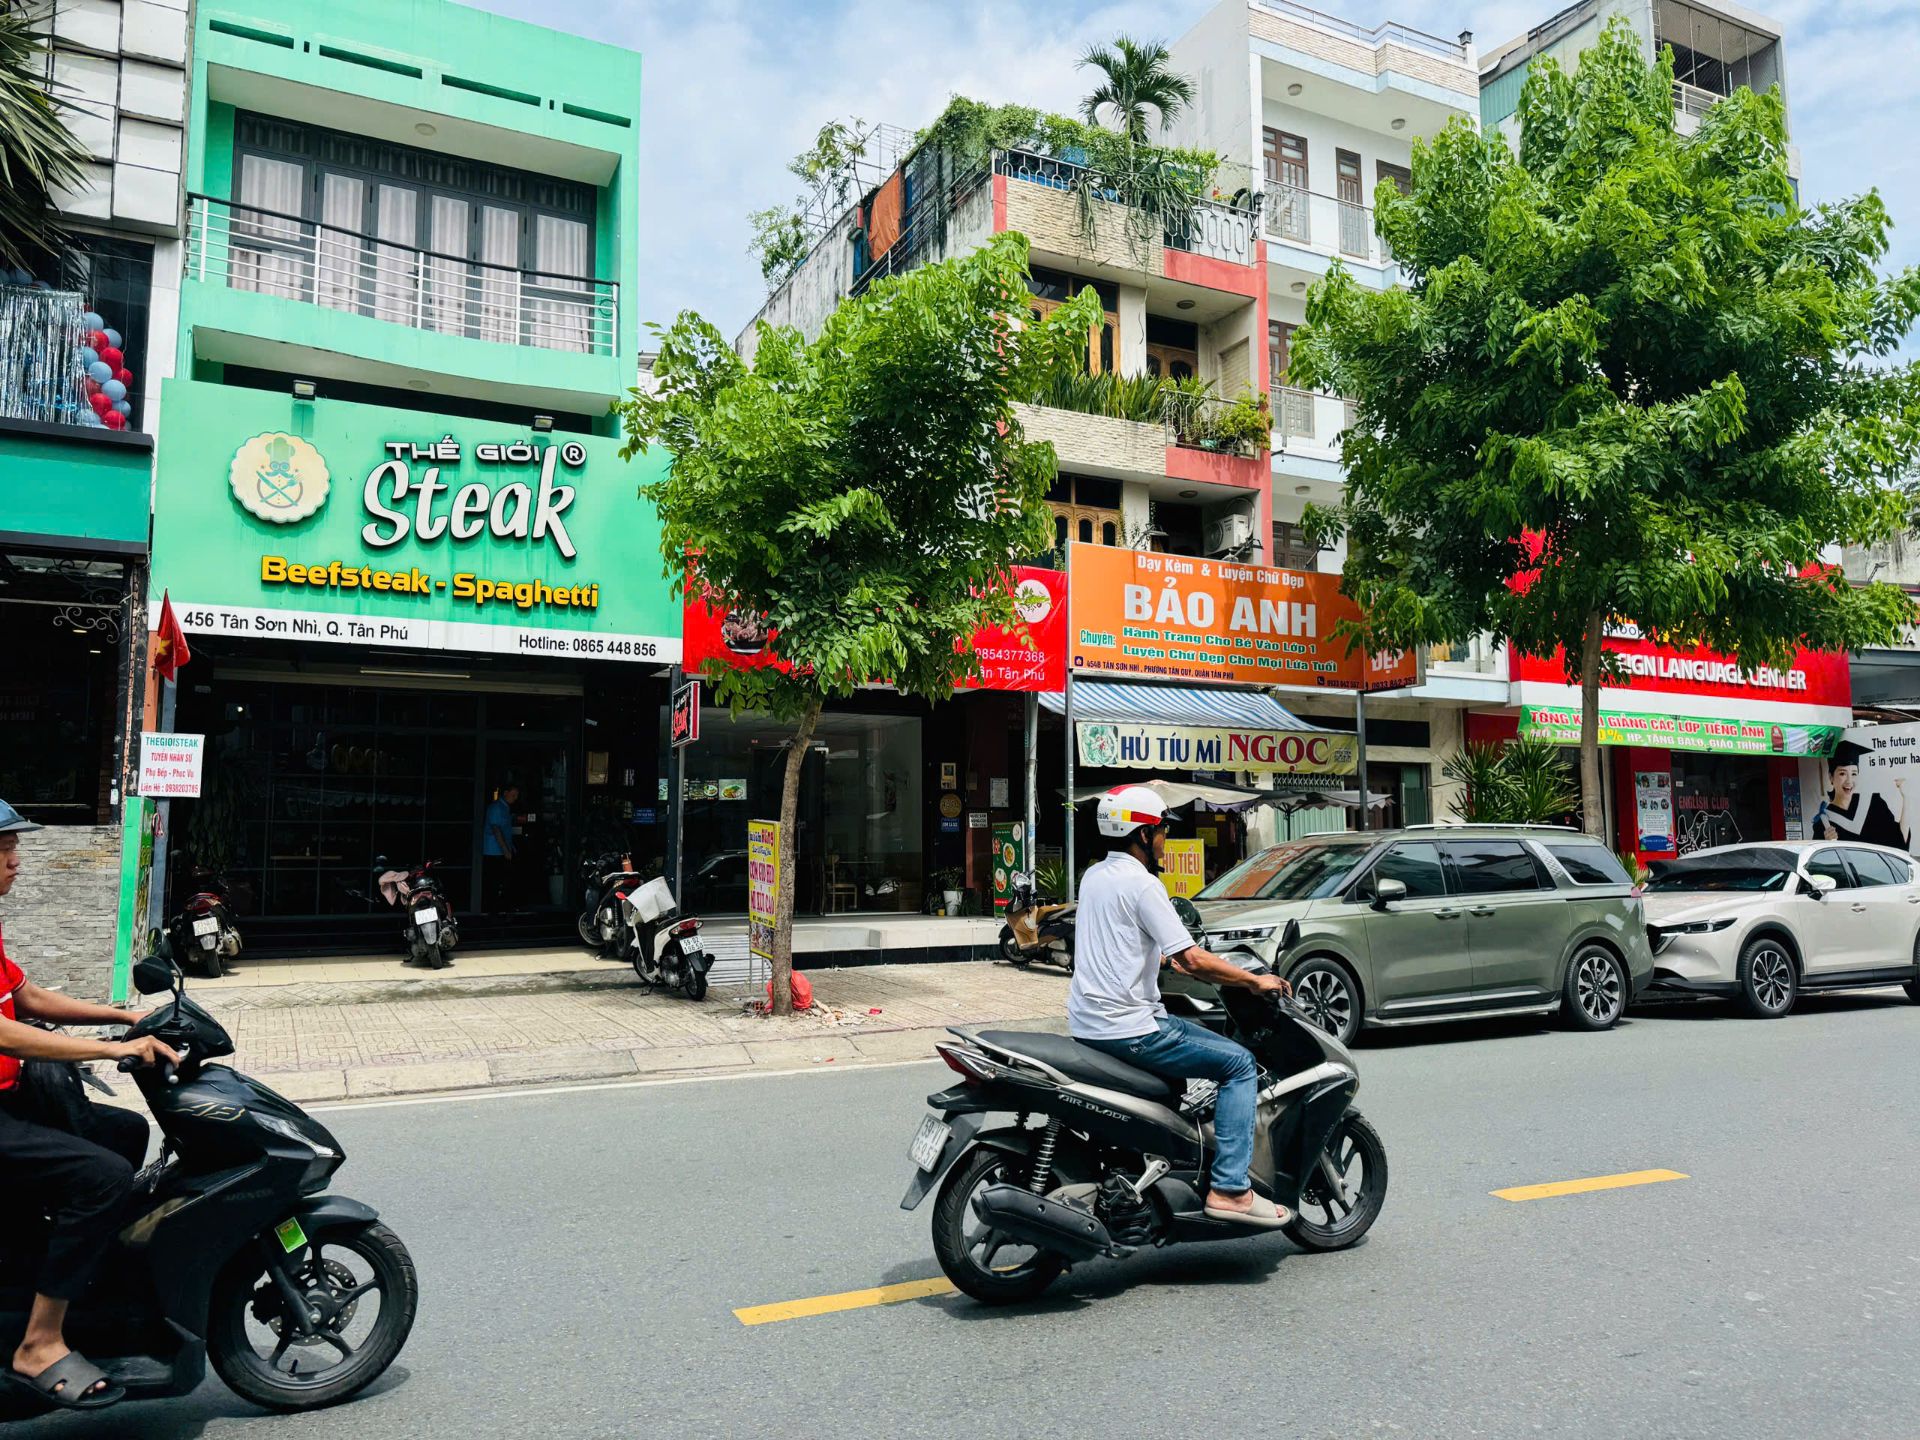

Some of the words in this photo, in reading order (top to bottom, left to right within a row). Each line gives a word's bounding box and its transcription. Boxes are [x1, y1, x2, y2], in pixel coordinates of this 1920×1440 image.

[385, 434, 461, 460] THẾ
[476, 440, 540, 461] GIỚI
[362, 445, 577, 558] Steak
[261, 555, 431, 593] Beefsteak
[453, 573, 599, 608] Spaghetti
[1137, 555, 1161, 574] Dạy
[1165, 558, 1193, 575] Kèm
[1201, 563, 1211, 577] &
[1218, 565, 1253, 582] Luyện
[1256, 569, 1278, 584] Chữ
[1282, 574, 1304, 589] Đẹp
[1124, 576, 1215, 628] BẢO
[1229, 596, 1317, 638] ANH
[183, 611, 215, 627] 456
[220, 613, 249, 630] Tân
[254, 615, 287, 632] Sơn
[292, 619, 321, 637] Nhì,
[326, 621, 343, 636] Q.
[347, 622, 375, 638] Tân
[380, 624, 408, 640] Phú
[519, 634, 569, 651] Hotline:
[572, 638, 604, 653] 0865
[607, 641, 631, 655] 448
[633, 642, 657, 657] 856
[1123, 626, 1159, 640] Hành
[1163, 631, 1202, 645] Trang
[1206, 635, 1231, 648] Cho
[1235, 636, 1252, 649] Bé
[1255, 638, 1279, 652] Vào
[1283, 641, 1305, 654] Lớp
[1309, 644, 1317, 655] 1
[975, 647, 1045, 663] 0854377368
[1123, 645, 1165, 659] Luyện
[1169, 648, 1196, 661] Chữ
[1199, 652, 1225, 665] Đẹp
[1229, 654, 1254, 666] Cho
[1258, 656, 1282, 668] Mọi
[1286, 658, 1309, 670] Lứa
[1311, 659, 1338, 672] Tuổi
[997, 666, 1019, 680] Tân
[1023, 667, 1045, 681] Phú
[1657, 656, 1746, 684] LANGUAGE
[1530, 707, 1569, 724] TỔNG
[1573, 712, 1605, 727] KI
[1607, 711, 1647, 729] GIẢNG
[1650, 716, 1675, 731] CÁC
[1678, 719, 1701, 733] LỚP
[1704, 720, 1738, 735] TIẾNG
[145, 736, 199, 748] THEGIOISTEAK
[1121, 727, 1150, 761] HỦ
[1156, 732, 1190, 763] TÍU
[1195, 735, 1222, 764] MÌ
[1228, 733, 1329, 772] NGỌC
[1871, 737, 1887, 749] The
[1890, 736, 1916, 749] future
[1869, 756, 1876, 767] is
[1878, 755, 1886, 766] in
[1889, 756, 1907, 768] your
[1177, 845, 1201, 875] TIẾU
